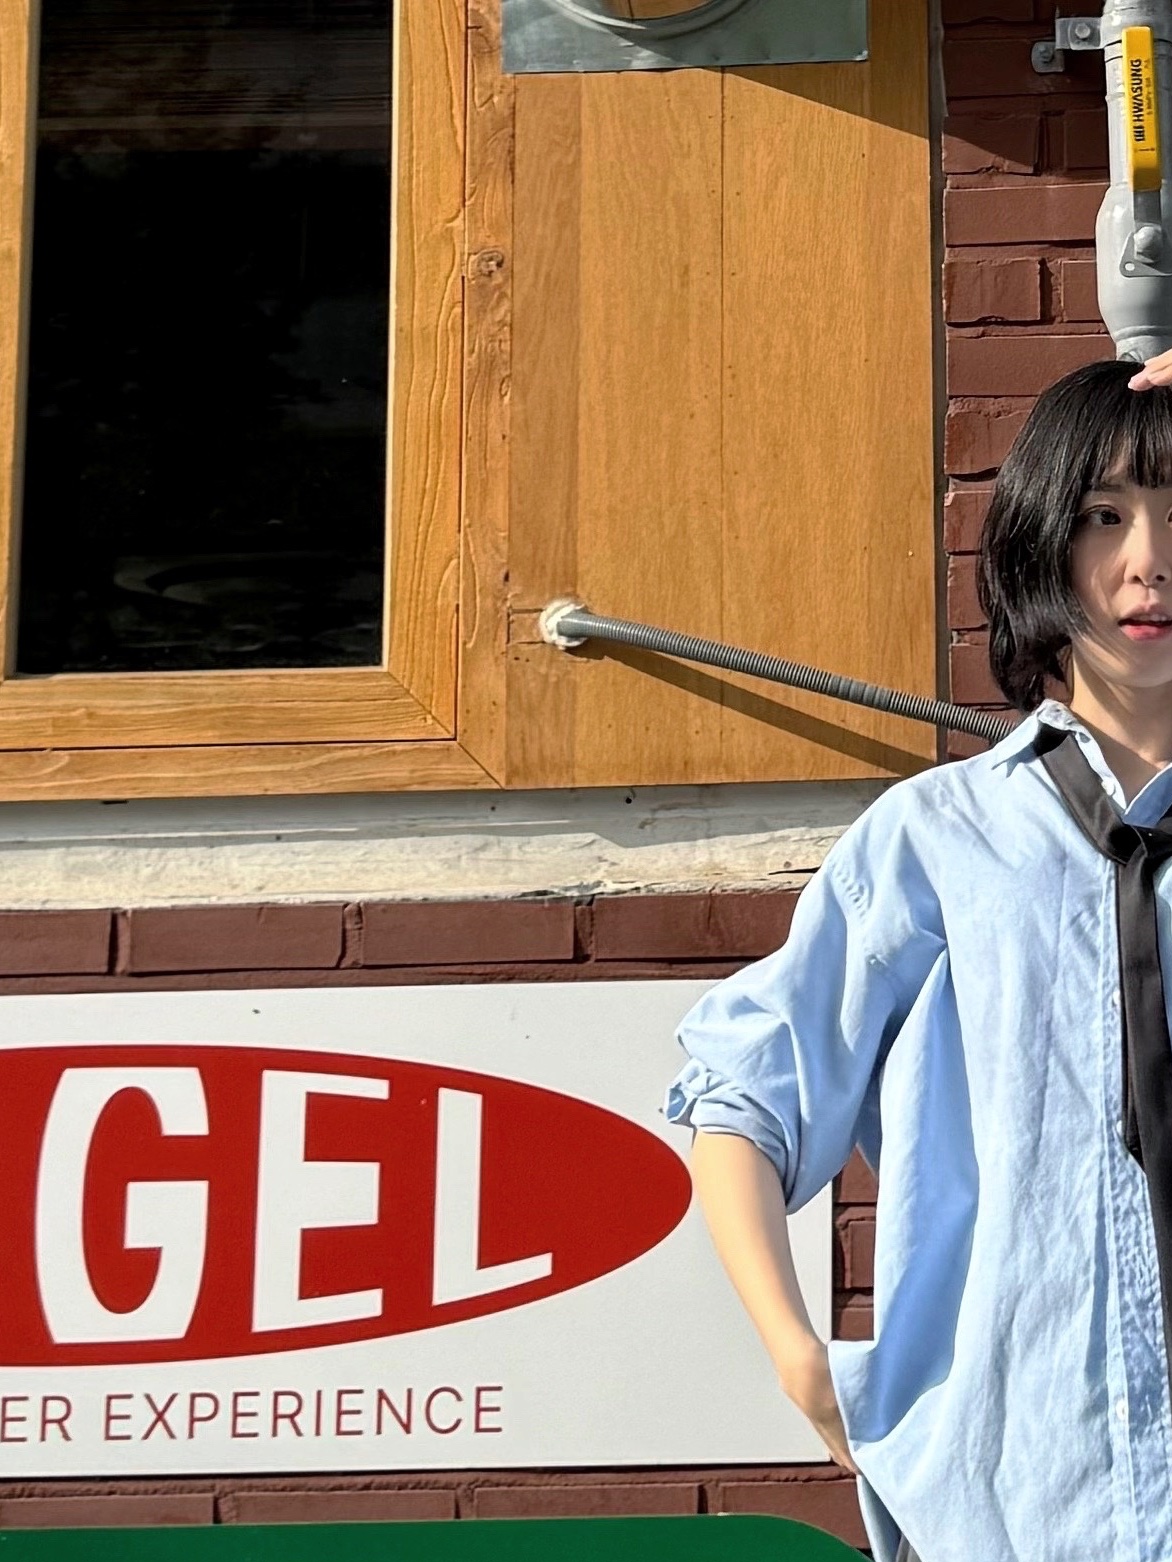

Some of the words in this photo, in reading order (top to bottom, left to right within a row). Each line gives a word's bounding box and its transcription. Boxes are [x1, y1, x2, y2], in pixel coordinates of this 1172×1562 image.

[1129, 58, 1145, 123] HWASUNG
[34, 1066, 553, 1345] GEL
[0, 1395, 72, 1443] ER
[104, 1385, 504, 1441] EXPERIENCE
